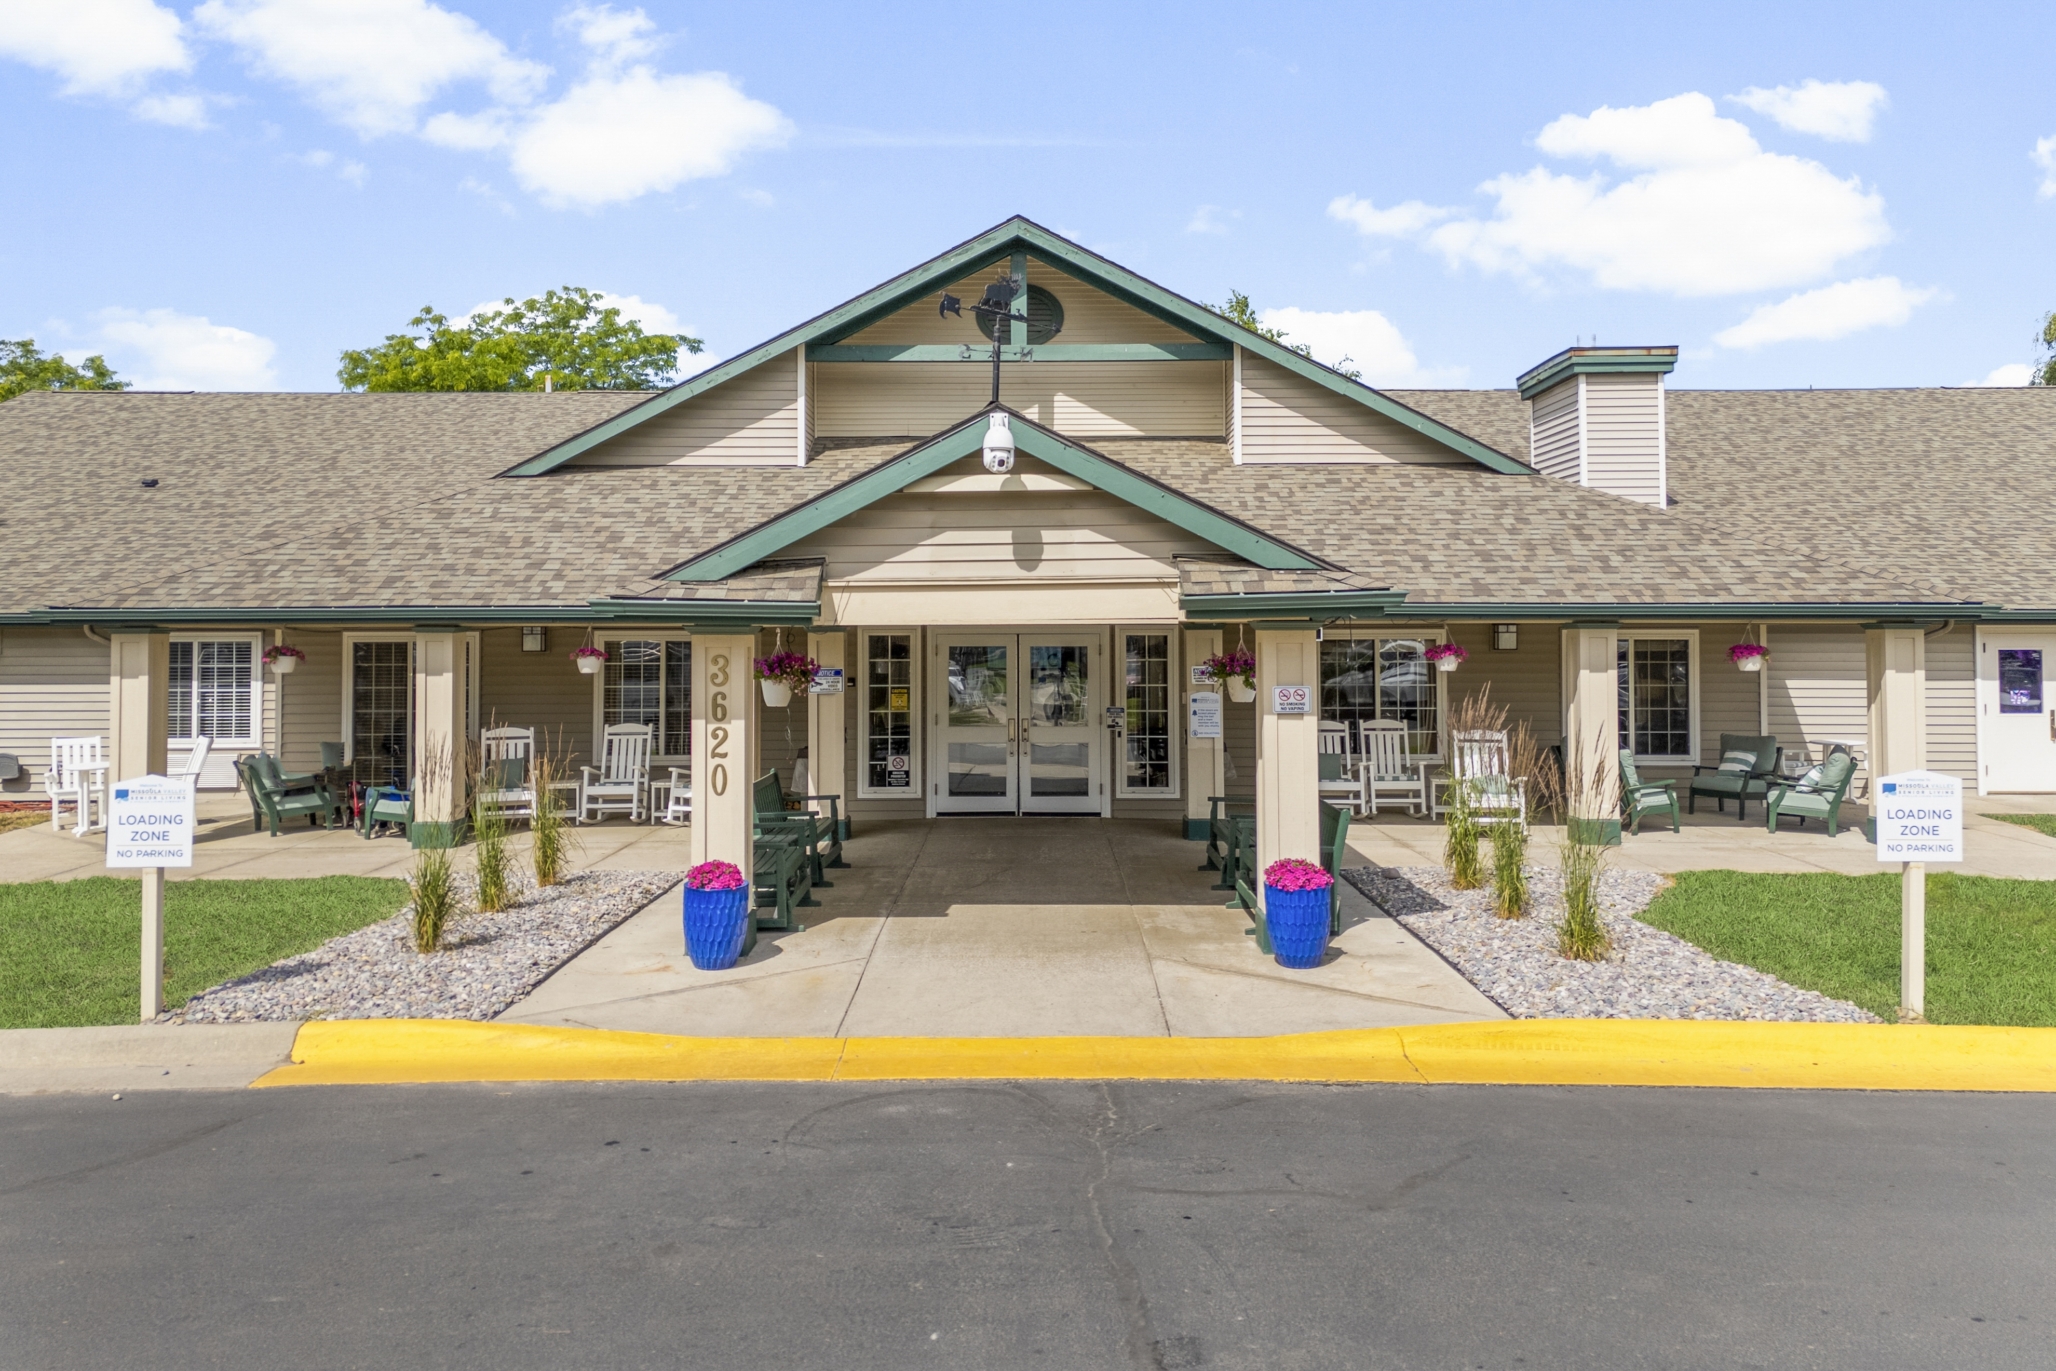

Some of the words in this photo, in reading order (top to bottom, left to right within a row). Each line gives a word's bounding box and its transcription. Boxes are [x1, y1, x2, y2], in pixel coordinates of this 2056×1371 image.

[710, 654, 729, 796] 3620
[1887, 809, 1952, 820] LOADING
[118, 815, 184, 825] LOADING
[1900, 825, 1940, 836] ZONE
[130, 831, 170, 841] ZONE
[1887, 844, 1903, 852] NO
[1906, 844, 1954, 852] PARKING
[116, 850, 133, 858] NO
[136, 849, 183, 857] PARKING
